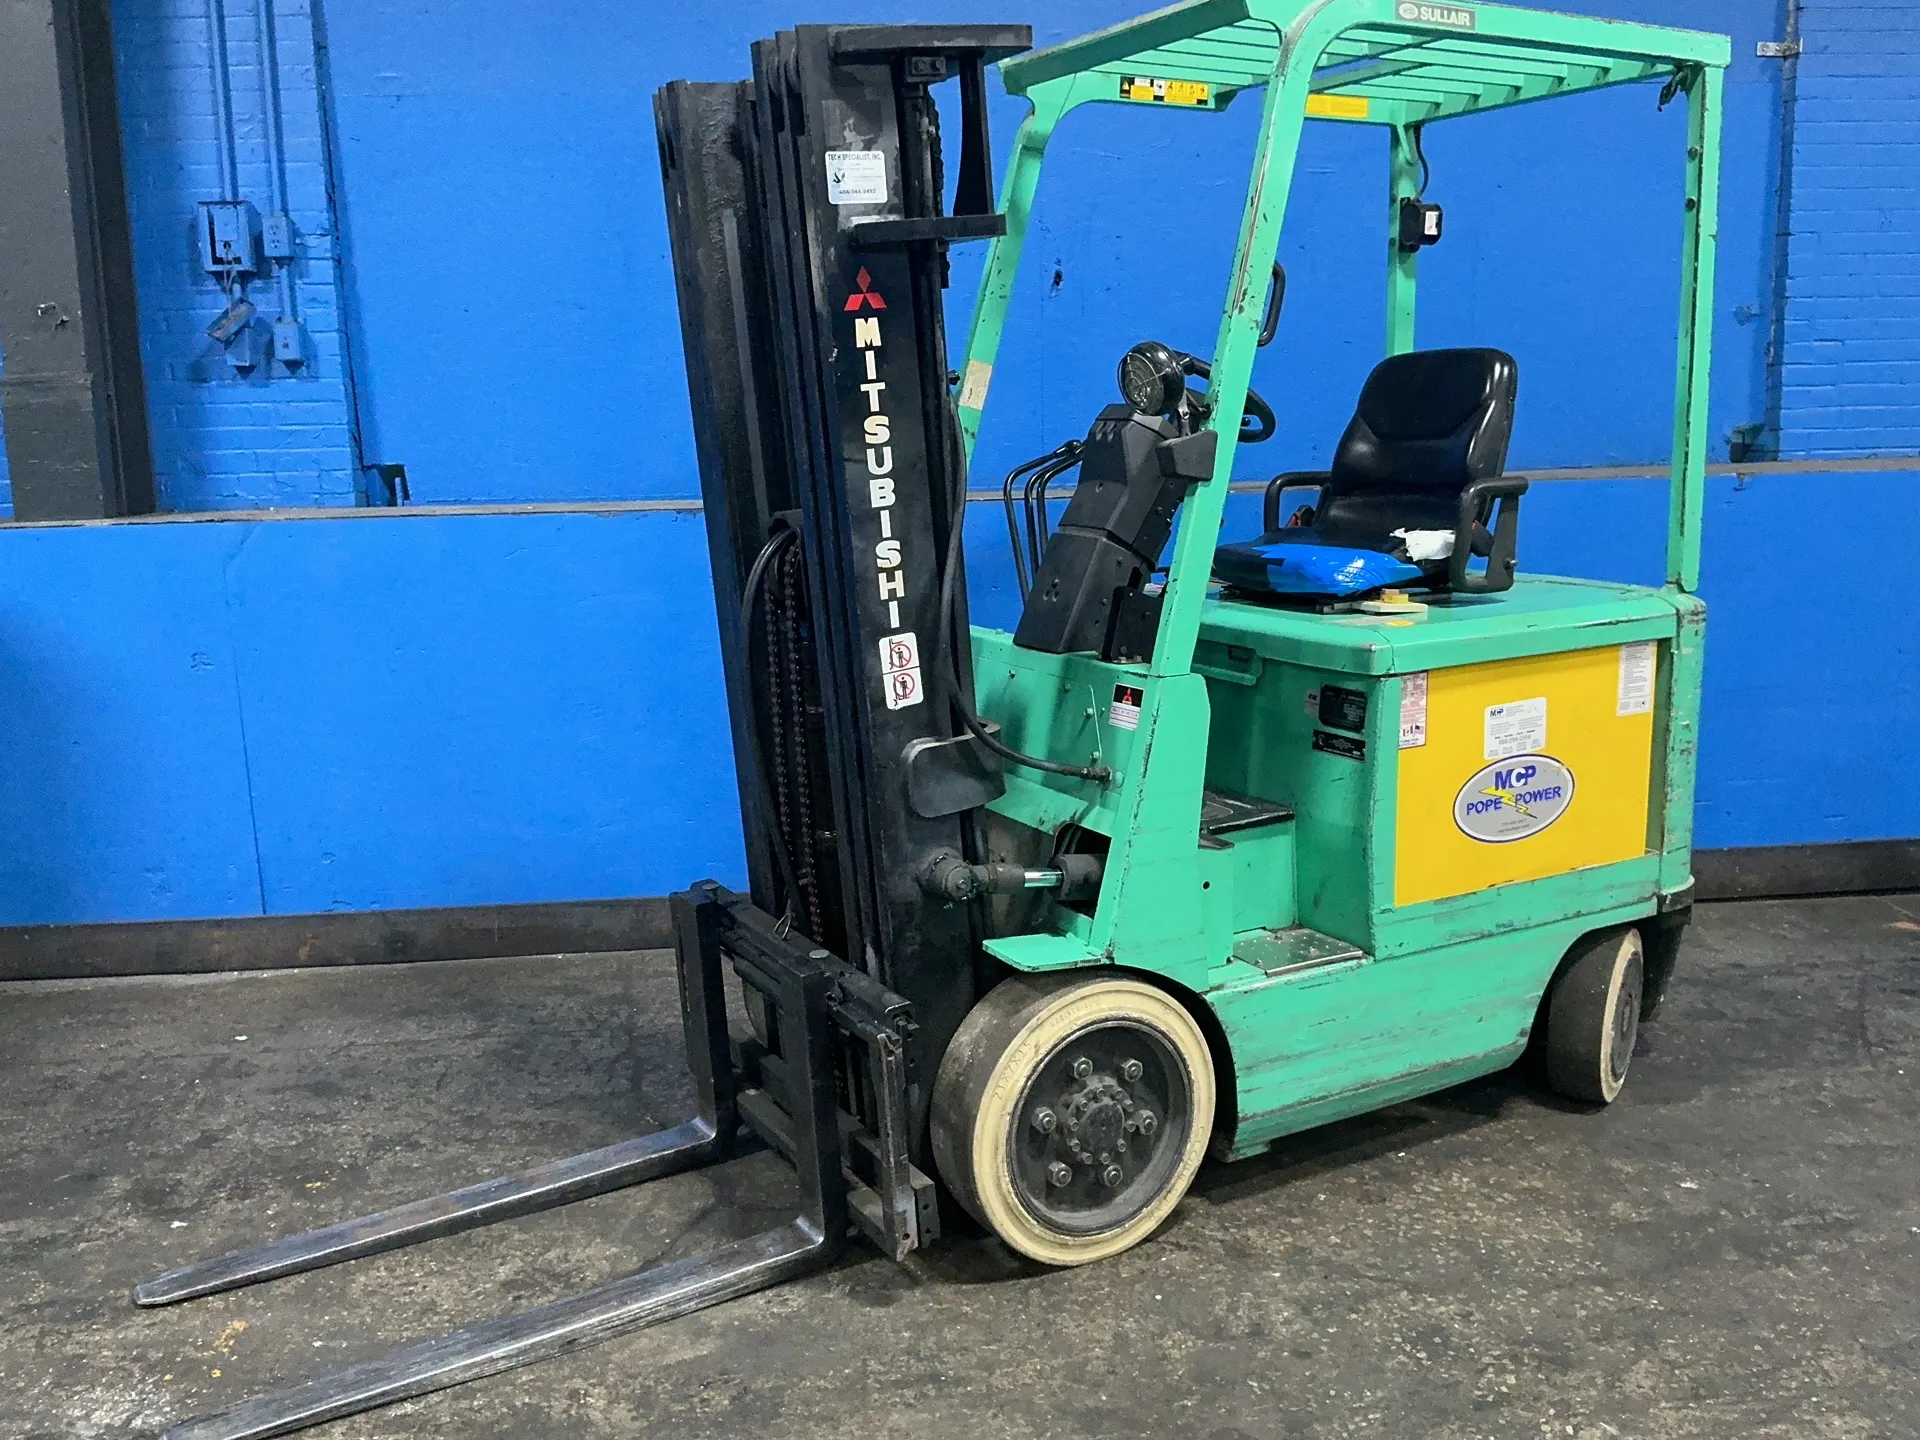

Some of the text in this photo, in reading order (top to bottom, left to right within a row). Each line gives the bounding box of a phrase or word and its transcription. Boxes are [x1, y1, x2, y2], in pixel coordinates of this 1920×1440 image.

[1420, 6, 1470, 27] SULLAIR
[854, 317, 905, 629] MITSUBISHI
[1495, 765, 1537, 791] MCP
[1466, 785, 1562, 816] POPE POWER
